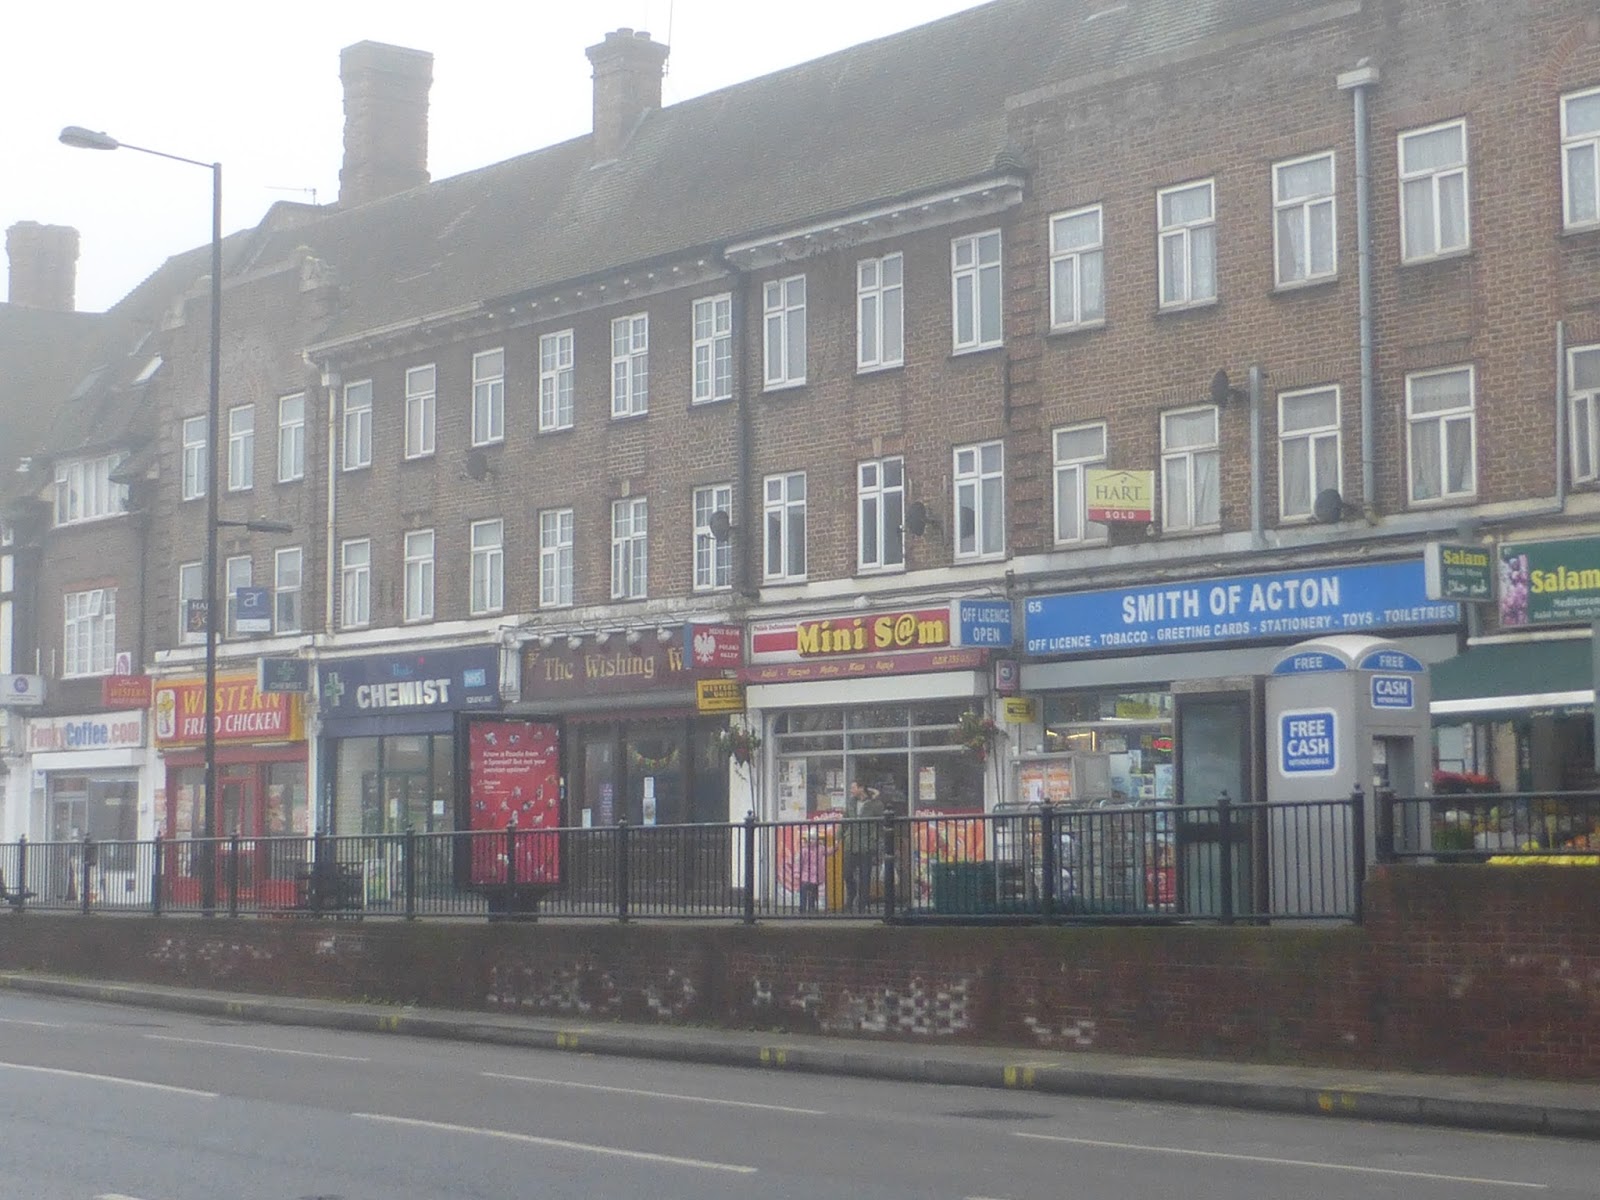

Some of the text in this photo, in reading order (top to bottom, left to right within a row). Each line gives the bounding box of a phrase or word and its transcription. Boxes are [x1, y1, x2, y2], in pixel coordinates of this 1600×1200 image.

[1096, 485, 1142, 502] HART
[1105, 511, 1135, 519] SOLD
[1443, 549, 1487, 566] Salam
[1530, 565, 1600, 593] Salam
[1028, 601, 1042, 613] 65
[1122, 576, 1340, 624] SMITH OF ACTON
[961, 607, 1010, 624] OFF LICENCE
[797, 613, 945, 654] Mini S@m
[973, 627, 1000, 642] OPEN
[1028, 605, 1454, 651] OFF LICENCE TOBACCO GREETING CARDS STATIONERY TOYS TOILETRIES
[544, 647, 684, 681] The Wishing W
[1294, 657, 1323, 669] FREE
[1380, 656, 1404, 668] FREE
[357, 678, 451, 708] CHEMIST
[1375, 681, 1407, 695] CASH
[184, 711, 282, 735] FRID CHICKEN
[1289, 720, 1325, 738] FREE
[1287, 739, 1329, 756] CASH
